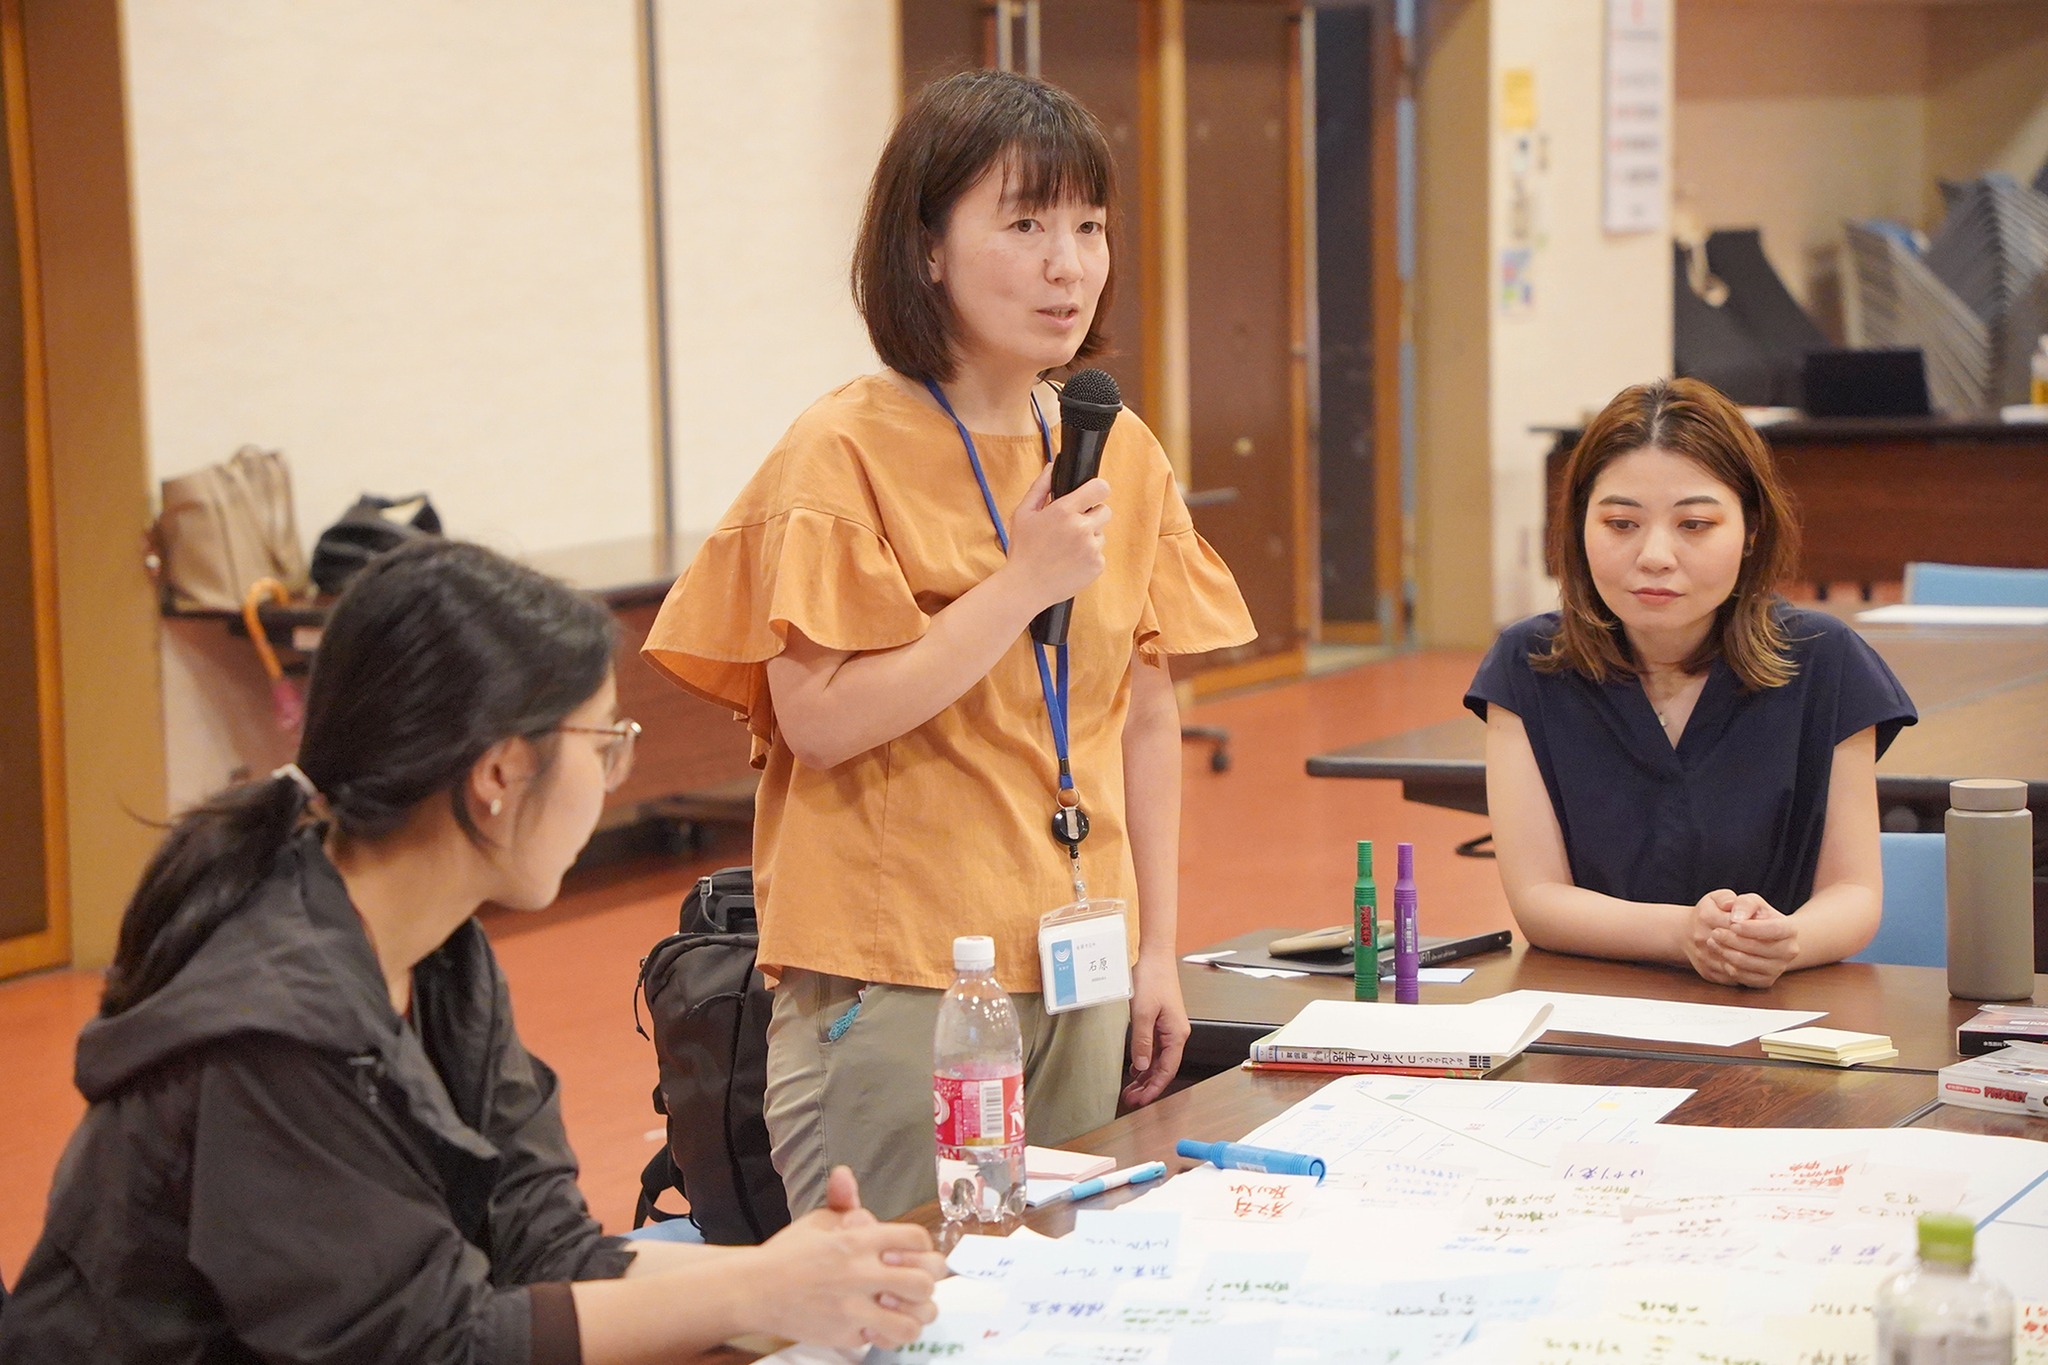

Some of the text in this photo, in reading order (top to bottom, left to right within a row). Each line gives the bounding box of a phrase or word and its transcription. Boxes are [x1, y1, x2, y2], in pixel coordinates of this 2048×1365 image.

[1360, 905, 1373, 947] PROCKEY
[1088, 957, 1109, 972] 石原
[1984, 1086, 2028, 1104] PROCKEY
